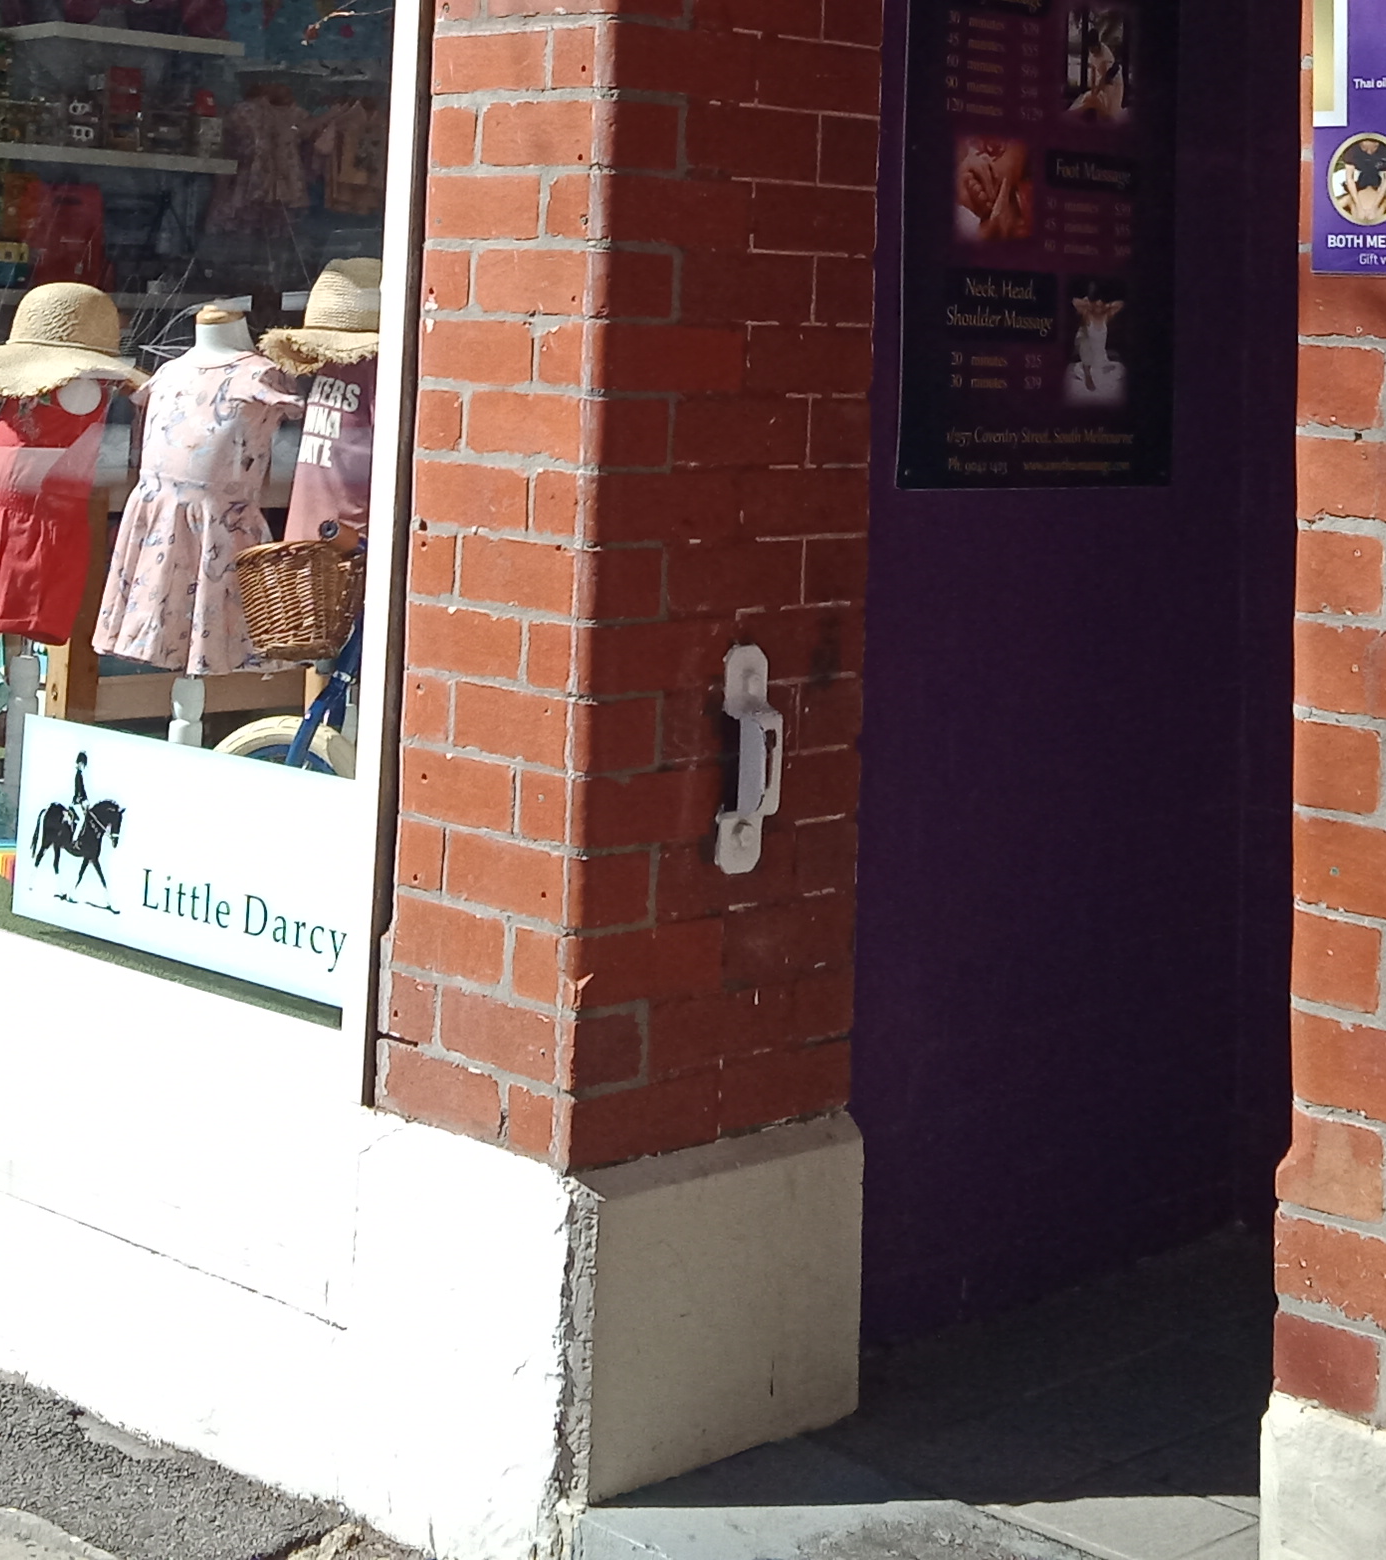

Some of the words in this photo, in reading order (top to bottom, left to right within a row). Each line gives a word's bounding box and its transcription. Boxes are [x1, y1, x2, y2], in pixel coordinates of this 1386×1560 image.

[1353, 78, 1375, 89] Thai
[1055, 158, 1080, 179] Foot
[1083, 161, 1132, 189] Massage
[1327, 234, 1364, 249] BOTH
[1359, 253, 1378, 265] Gift
[1002, 279, 1037, 303] Head,
[946, 304, 1002, 328] Shoulder
[1004, 309, 1054, 337] Massage
[307, 374, 361, 412] TERS
[298, 433, 332, 468] ATE
[974, 426, 1018, 449] Coventry
[142, 868, 231, 929] Little
[243, 894, 347, 972] Darcy
